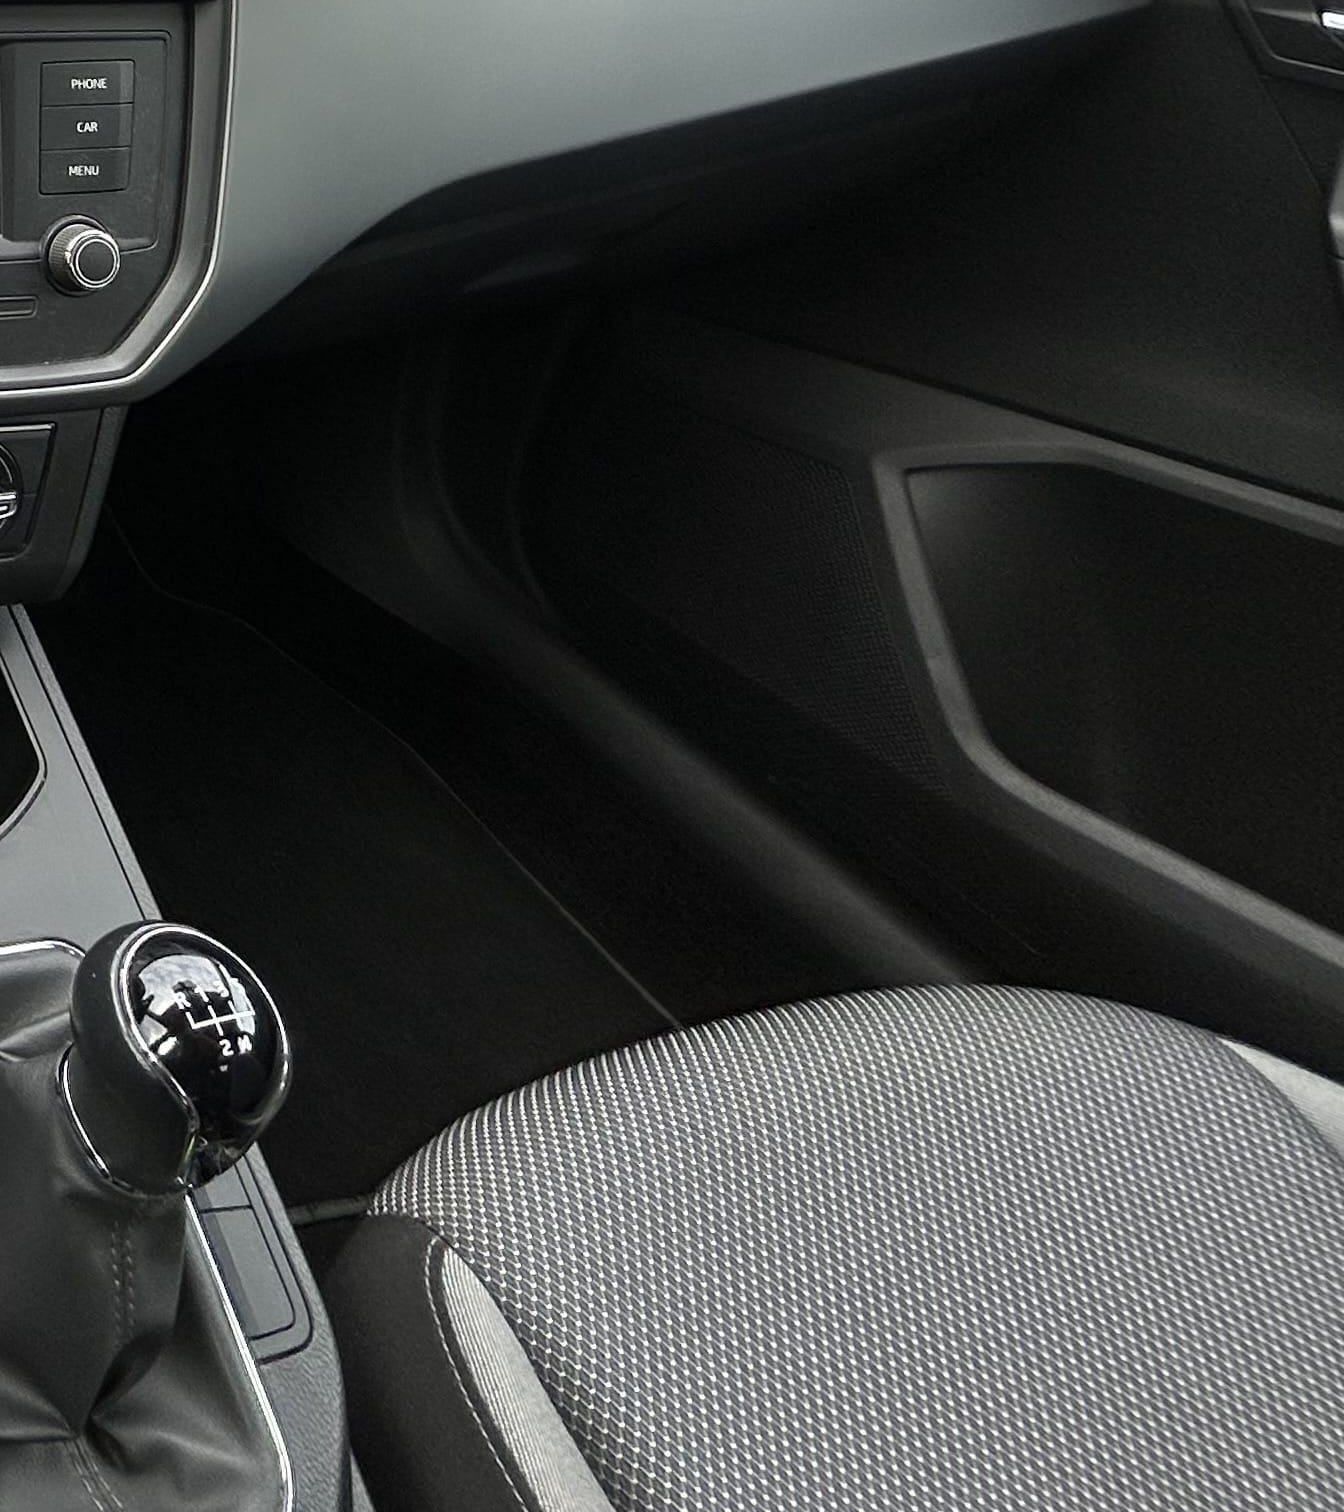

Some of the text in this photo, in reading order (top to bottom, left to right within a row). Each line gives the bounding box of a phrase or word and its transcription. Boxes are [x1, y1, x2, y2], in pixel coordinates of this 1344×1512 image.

[71, 77, 107, 90] PHONE
[76, 121, 98, 133] CAR
[68, 164, 100, 178] MENU
[219, 1039, 234, 1056] 2
